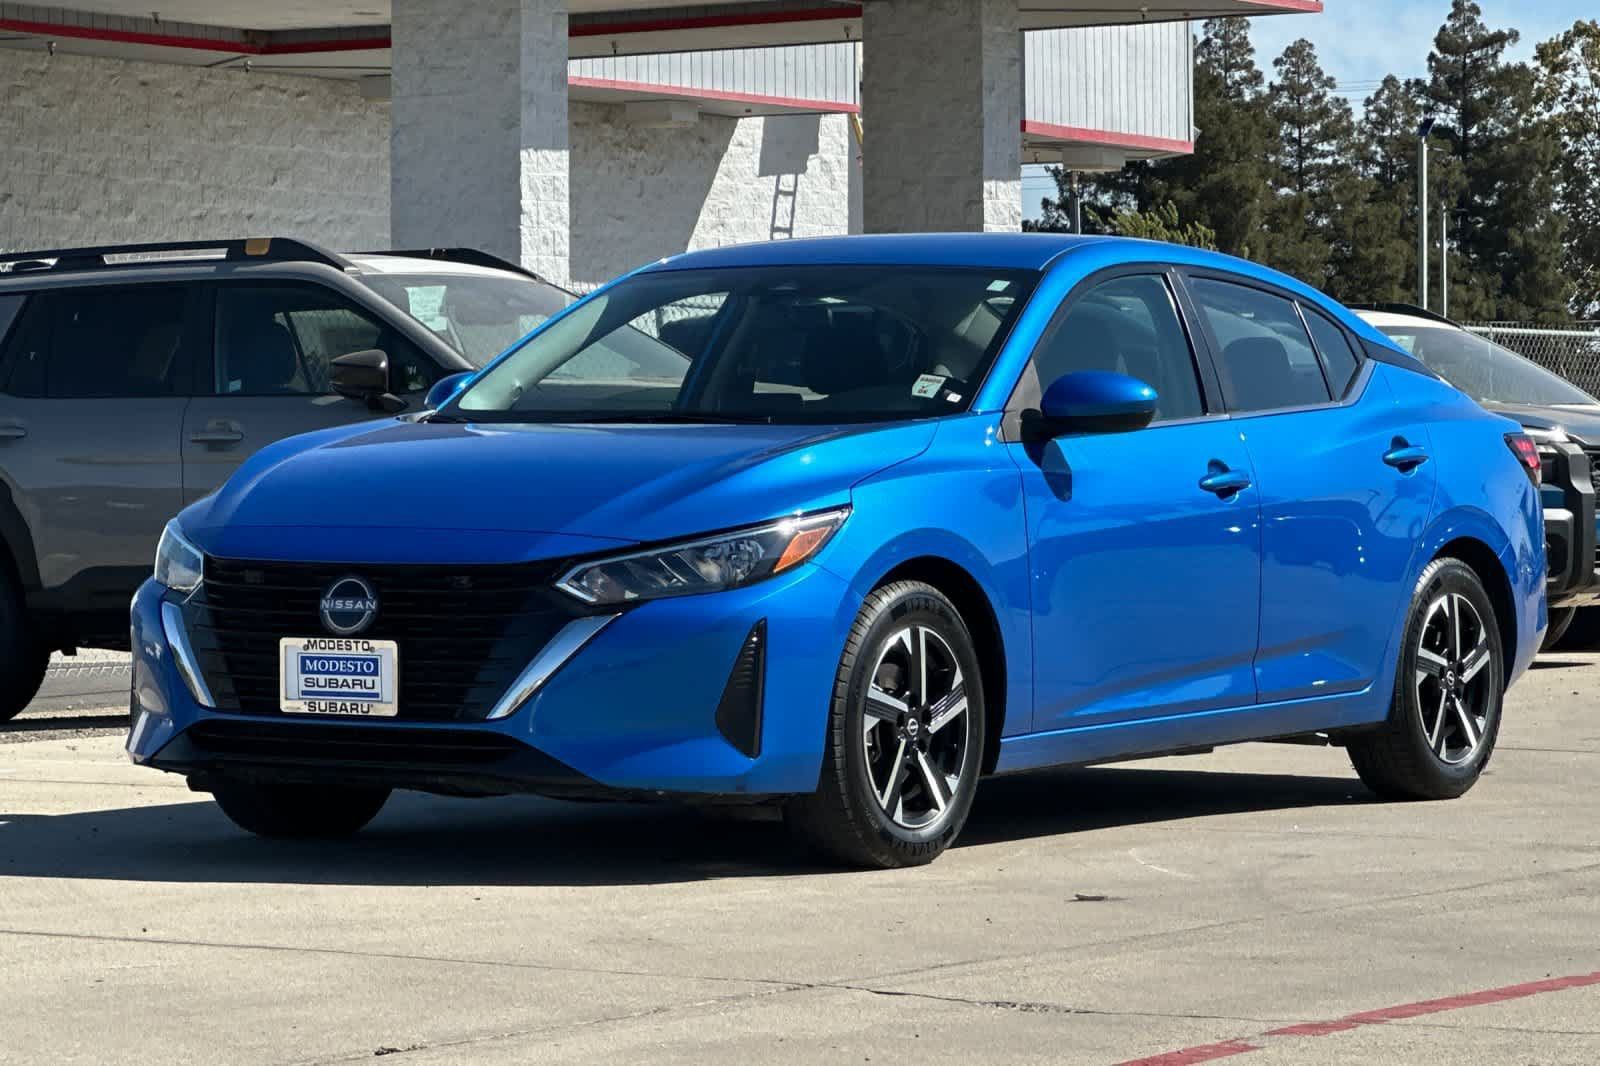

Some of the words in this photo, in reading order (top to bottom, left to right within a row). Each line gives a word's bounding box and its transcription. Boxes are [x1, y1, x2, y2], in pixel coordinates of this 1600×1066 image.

[321, 599, 377, 609] NISSAN
[306, 640, 371, 651] MODESTO
[305, 660, 374, 672] MODESTO
[304, 677, 375, 690] SUBARU
[307, 701, 371, 714] SUBARU
